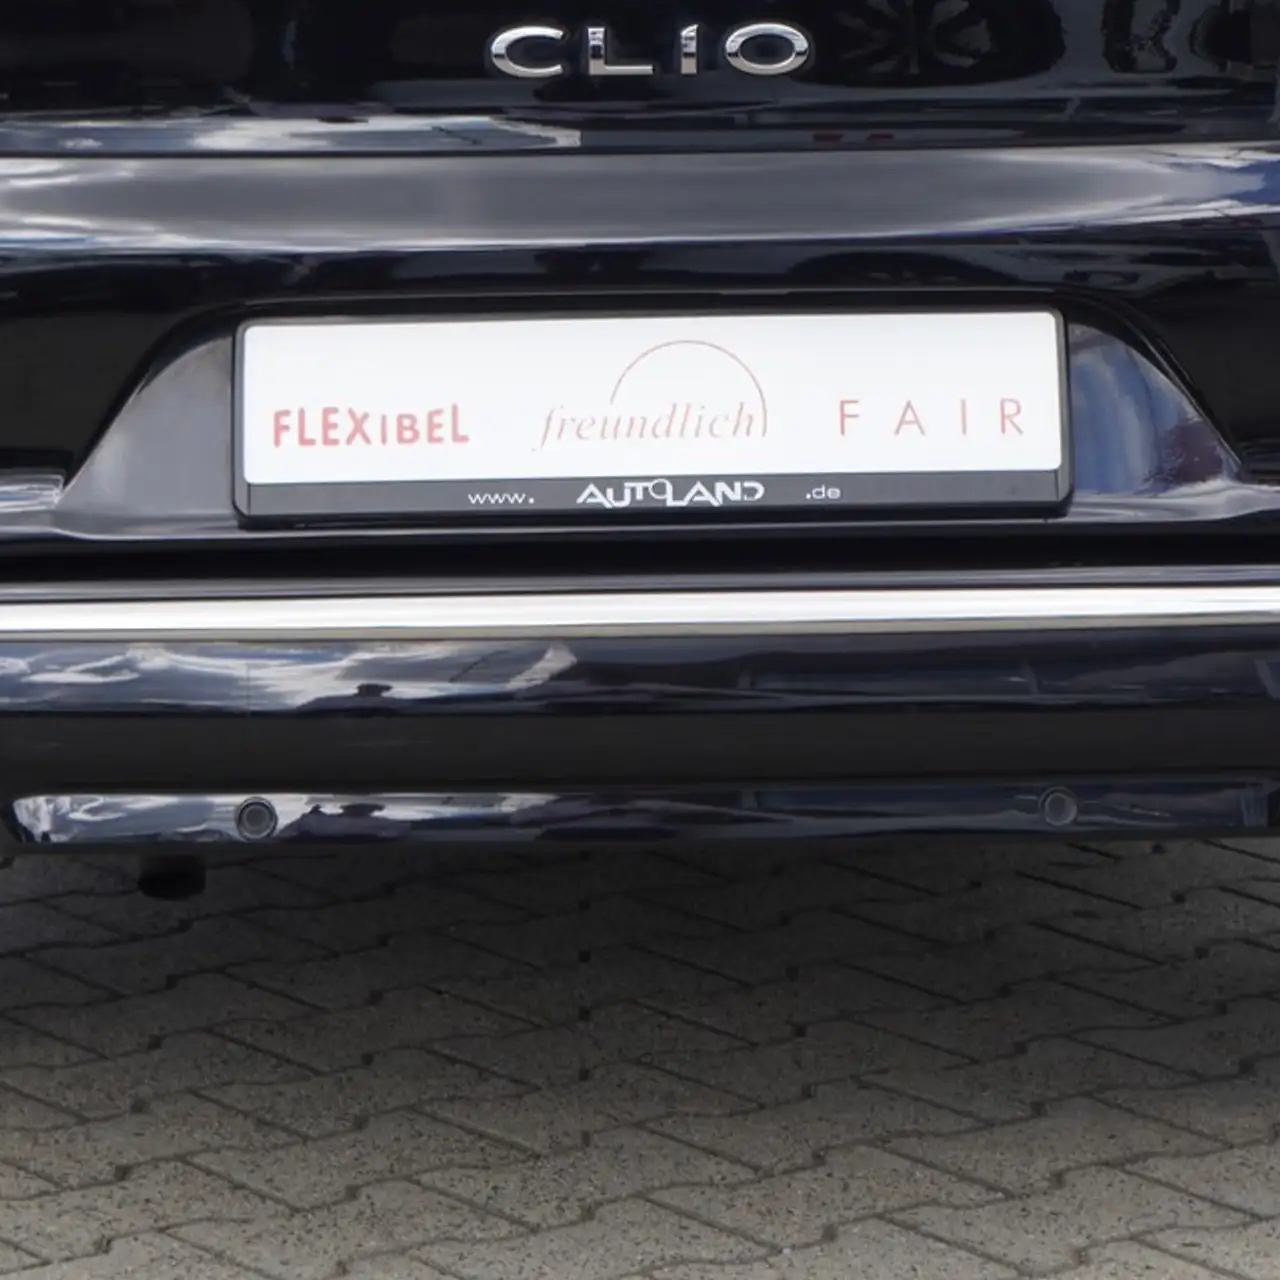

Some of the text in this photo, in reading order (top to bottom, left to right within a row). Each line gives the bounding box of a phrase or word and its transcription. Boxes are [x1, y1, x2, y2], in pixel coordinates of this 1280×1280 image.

[490, 22, 810, 78] CLIO
[272, 396, 1025, 452] FLEXIBEL freundlich FAIR
[467, 477, 842, 509] www. AUTOLAND .de
